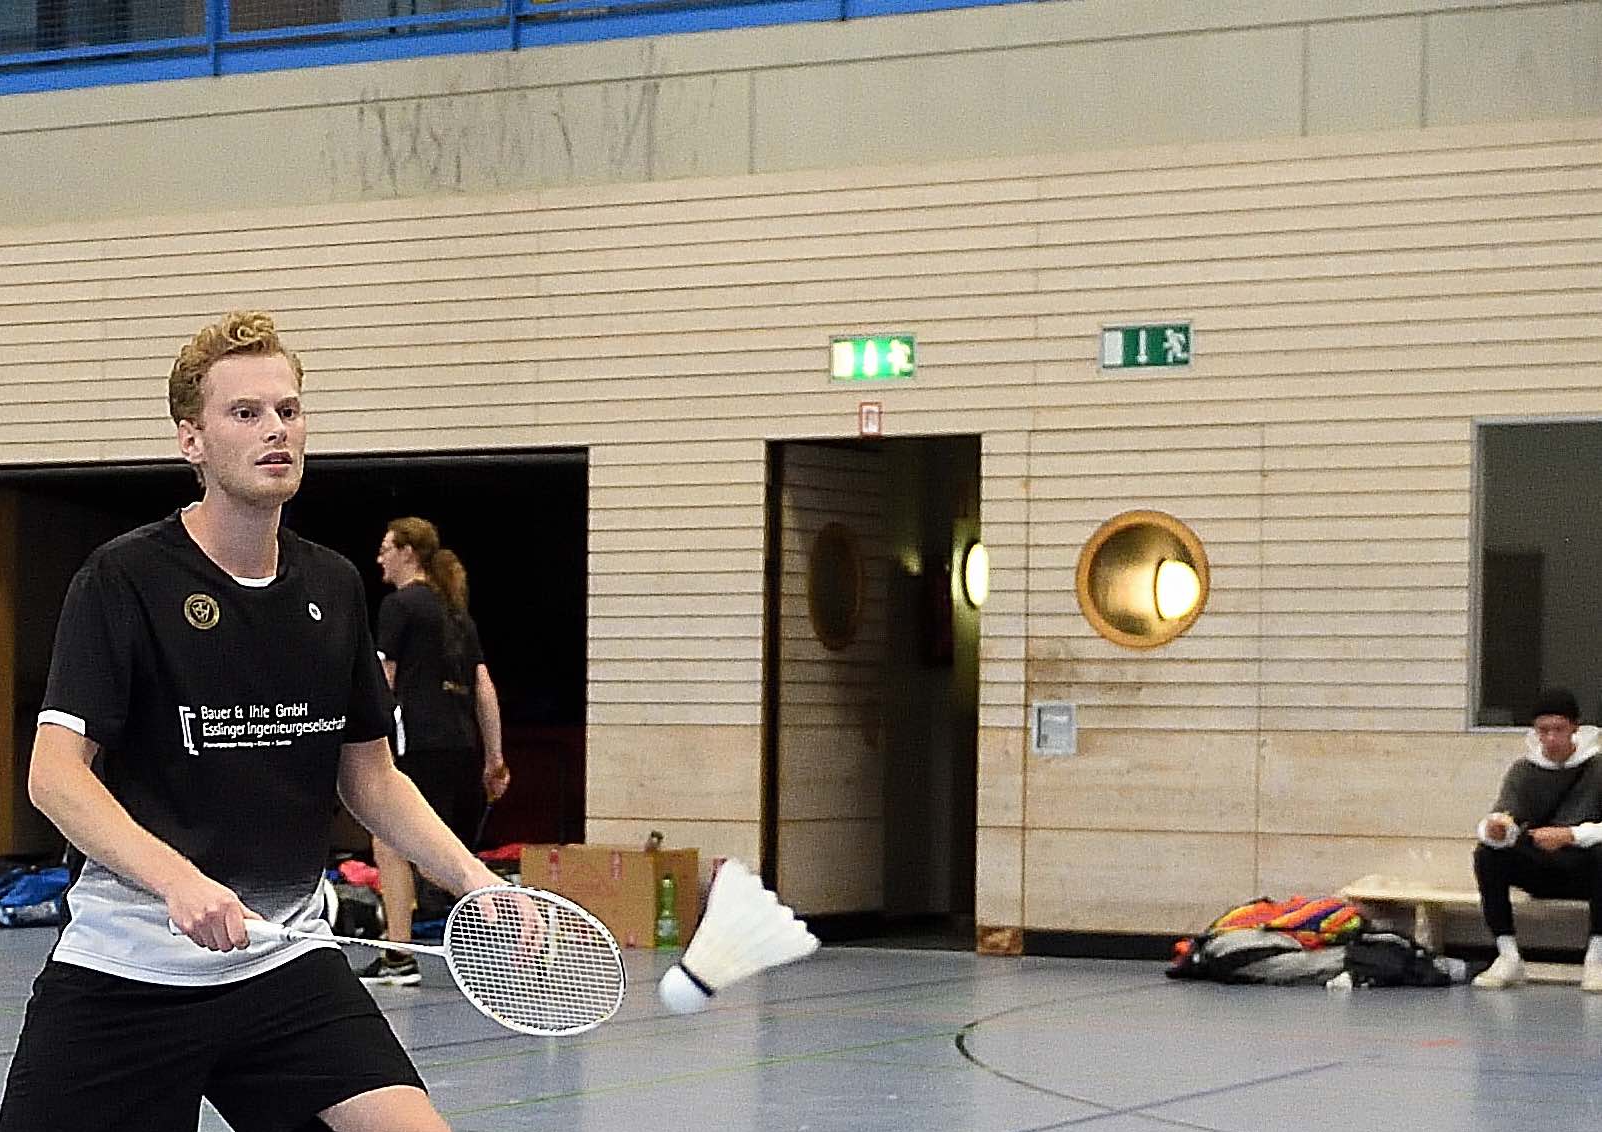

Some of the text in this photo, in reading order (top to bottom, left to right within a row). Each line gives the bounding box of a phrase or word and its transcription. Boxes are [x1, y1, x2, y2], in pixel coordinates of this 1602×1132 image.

[201, 702, 308, 720] Bauer & Ihle GmbH
[202, 715, 346, 739] Esslinger Ingenieurgesellschaf
